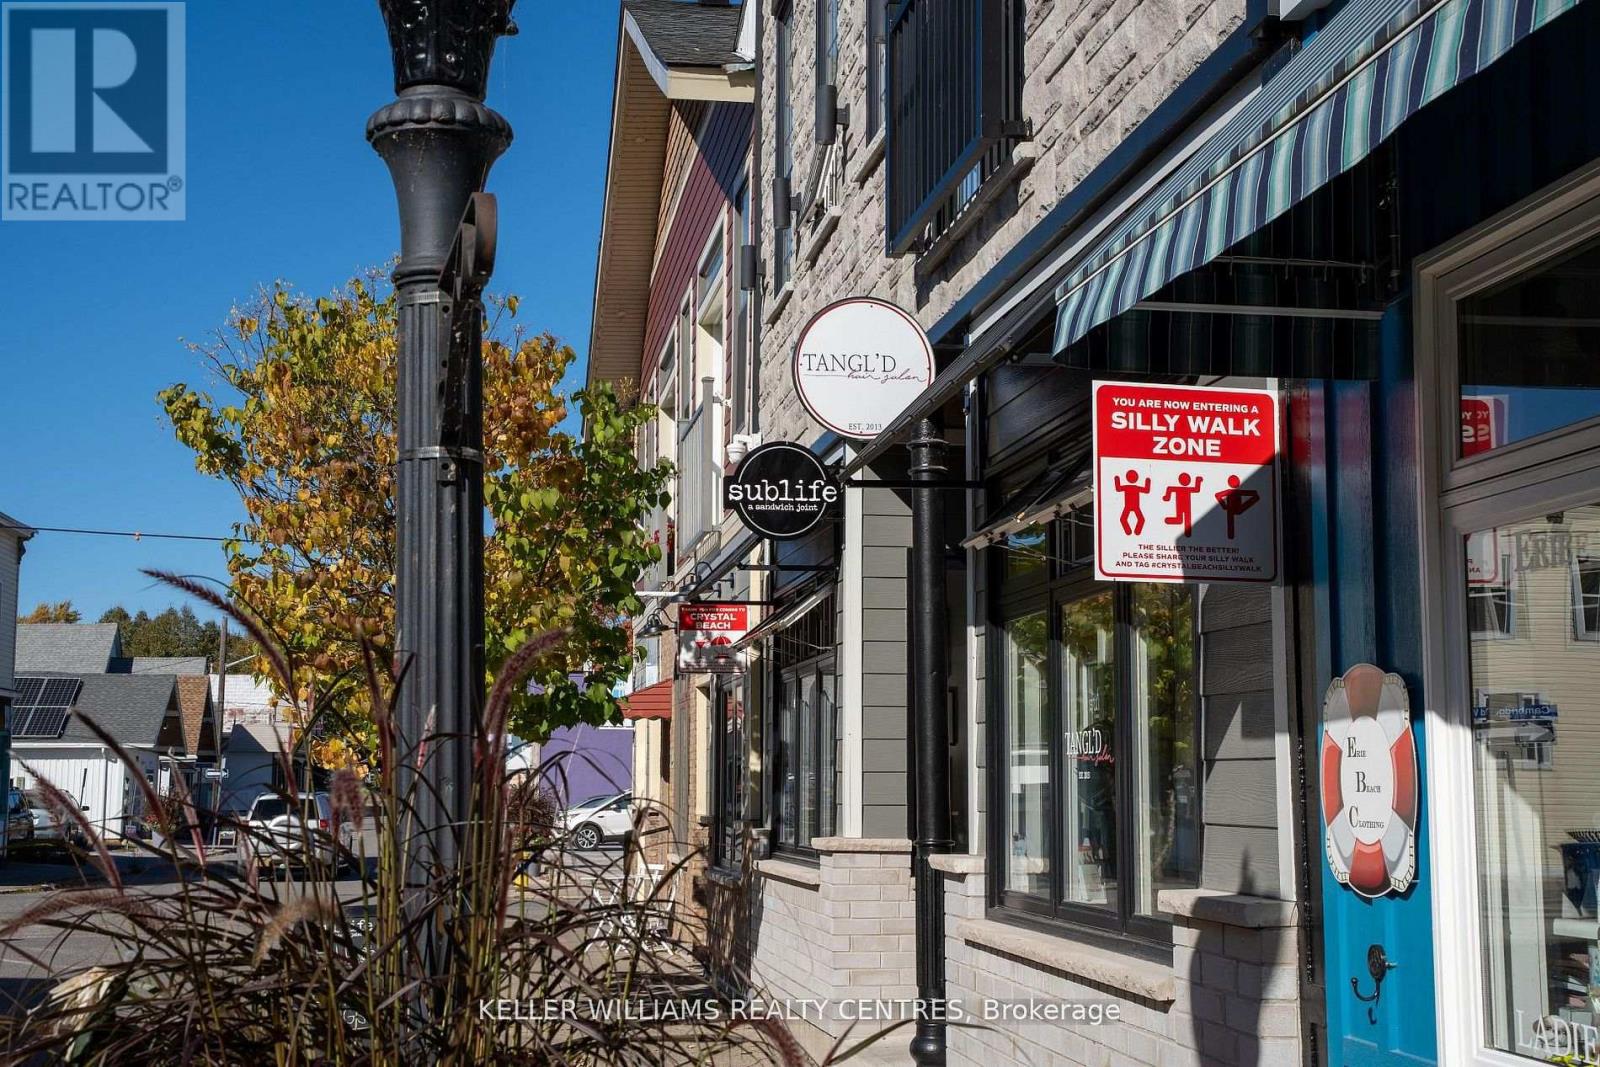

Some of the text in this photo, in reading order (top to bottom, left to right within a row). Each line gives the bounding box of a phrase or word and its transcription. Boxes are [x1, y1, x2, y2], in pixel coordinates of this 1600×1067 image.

[802, 353, 897, 373] TANGL'D
[1112, 397, 1259, 414] YOU ARE NOW ENTERING A
[1111, 411, 1262, 437] SILLY WALK
[1152, 436, 1222, 457] ZONE
[728, 479, 838, 503] sublife
[755, 503, 795, 511] sandwich
[796, 503, 819, 513] joint
[1122, 552, 1154, 560] PLEASE
[1208, 555, 1229, 563] SILLY
[690, 612, 737, 621] CRYSTAL
[695, 621, 731, 630] BEACH
[1064, 728, 1102, 755] TANGL'D
